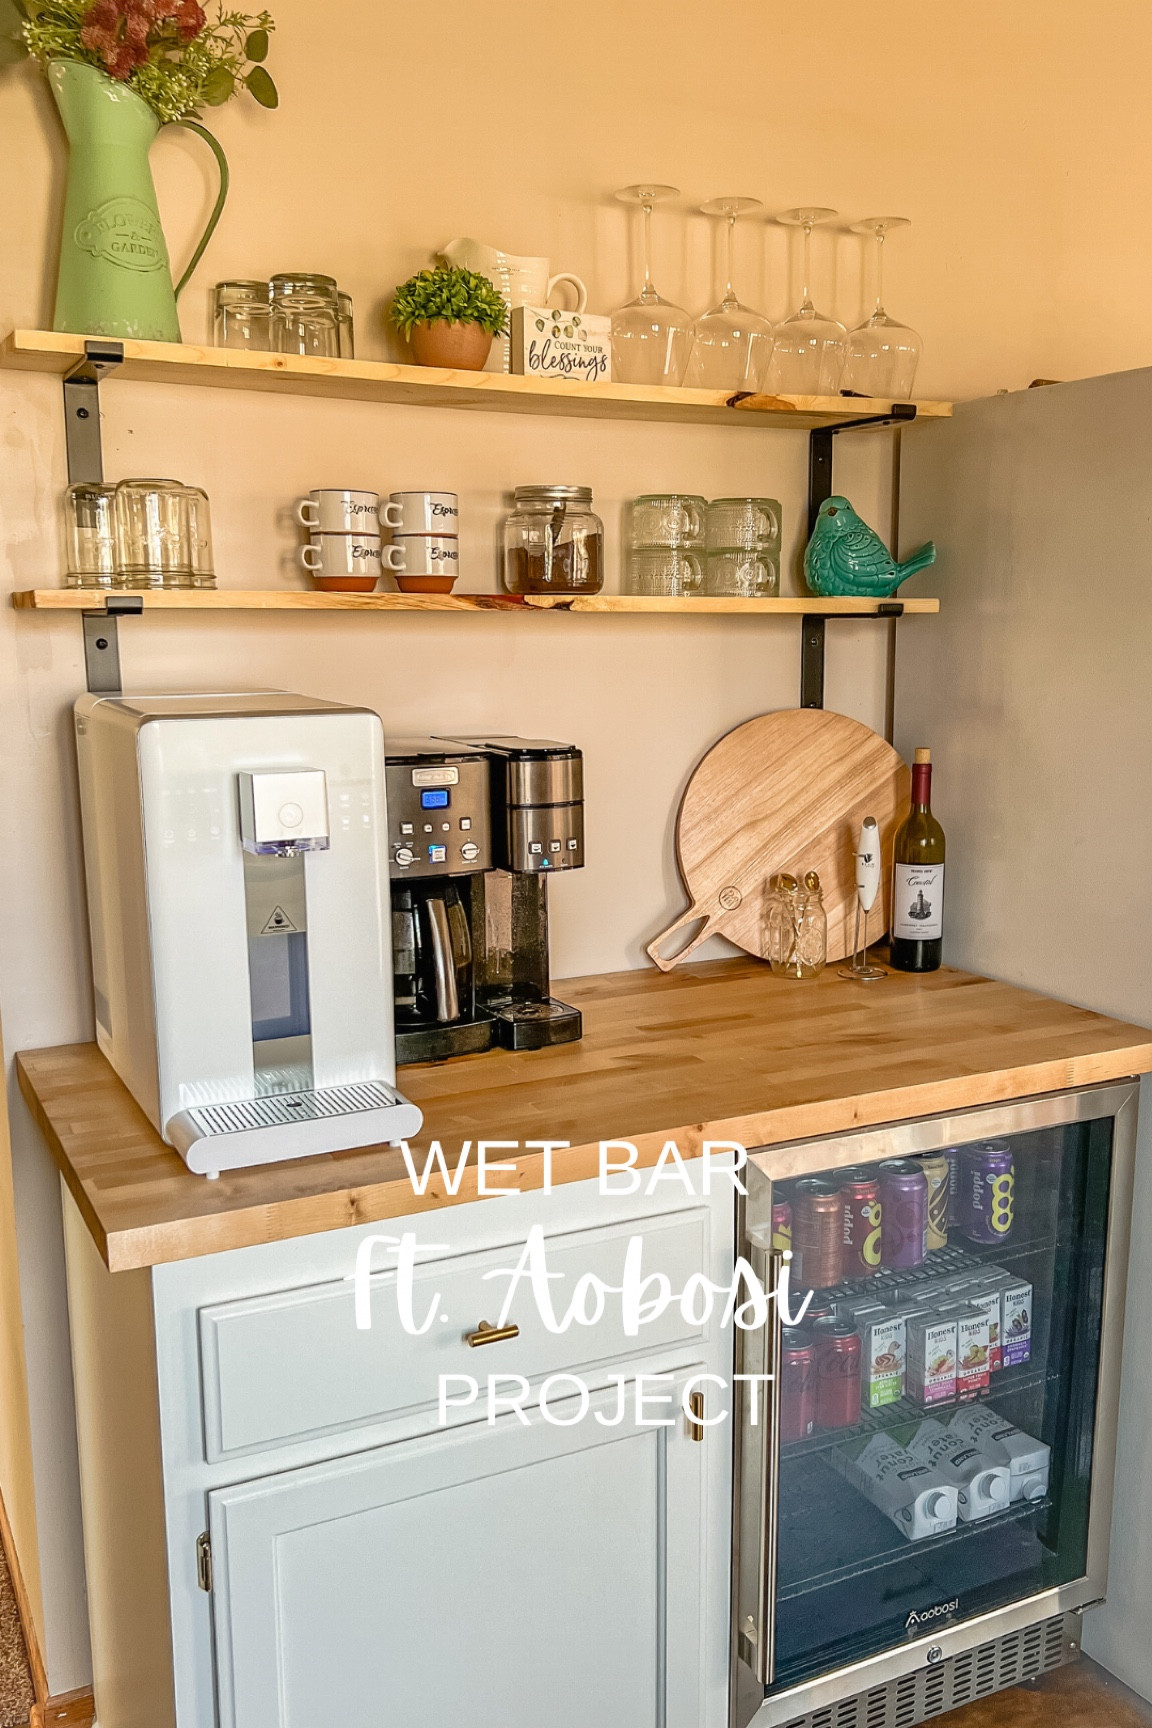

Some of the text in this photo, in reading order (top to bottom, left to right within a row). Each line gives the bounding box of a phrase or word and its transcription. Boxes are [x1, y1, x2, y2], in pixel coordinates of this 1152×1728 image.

[554, 341, 604, 354] COUNT YOUR
[528, 338, 608, 381] blessings
[971, 1170, 985, 1211] poppi
[843, 1204, 854, 1245] poppi
[1005, 1290, 1031, 1303] Honest
[874, 1323, 902, 1337] Honest
[927, 1326, 956, 1340] Honest
[961, 1319, 989, 1333] Honest
